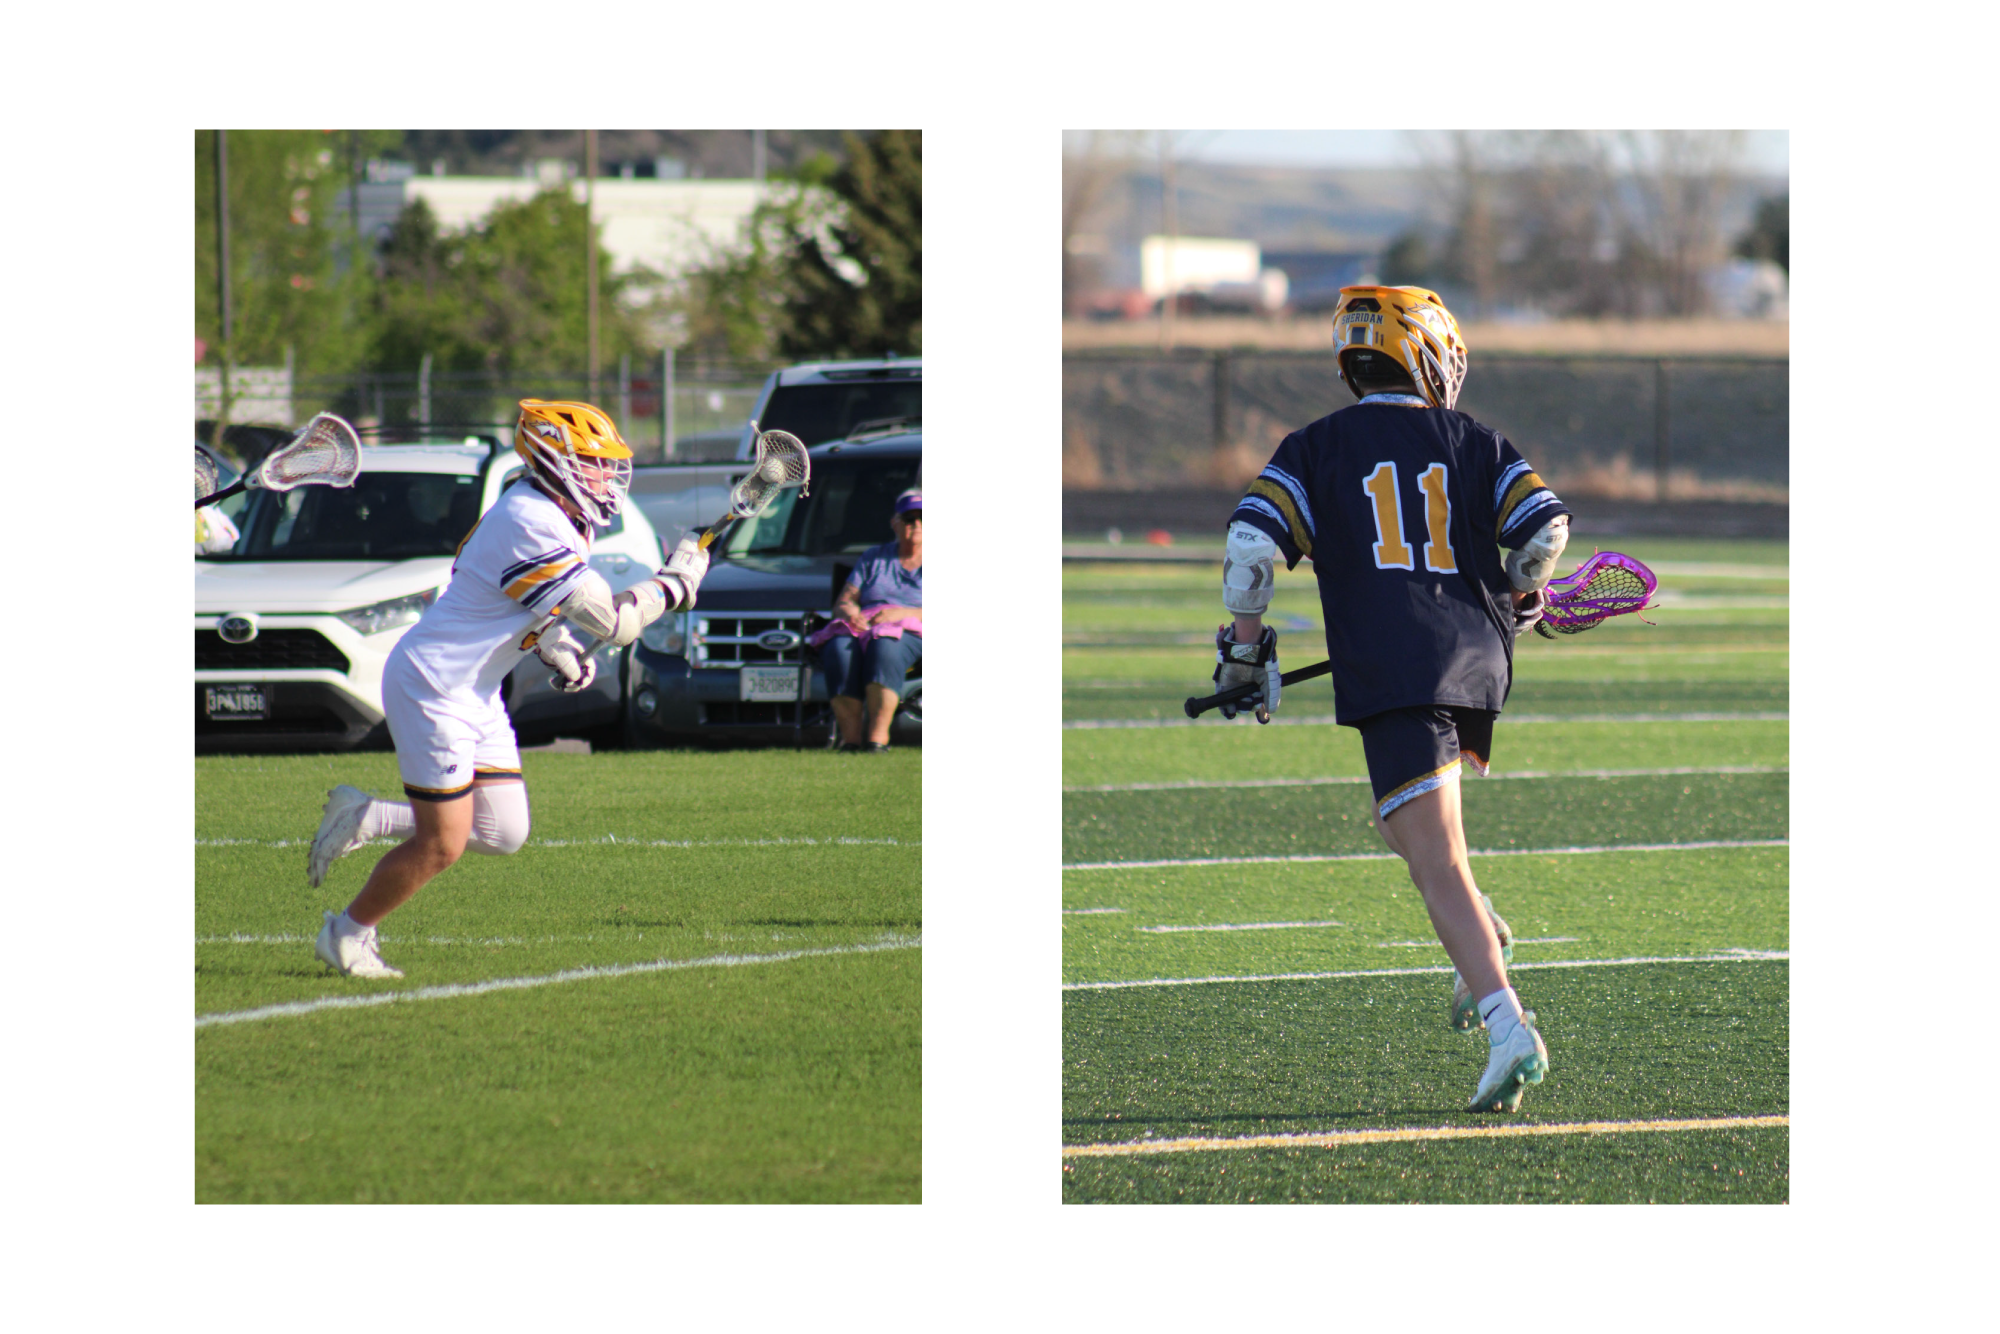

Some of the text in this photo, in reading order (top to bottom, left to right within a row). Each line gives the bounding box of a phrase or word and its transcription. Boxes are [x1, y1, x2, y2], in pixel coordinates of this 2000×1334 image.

[1341, 312, 1384, 325] SHERIDAN
[1362, 460, 1459, 574] 11
[1235, 531, 1258, 542] STX
